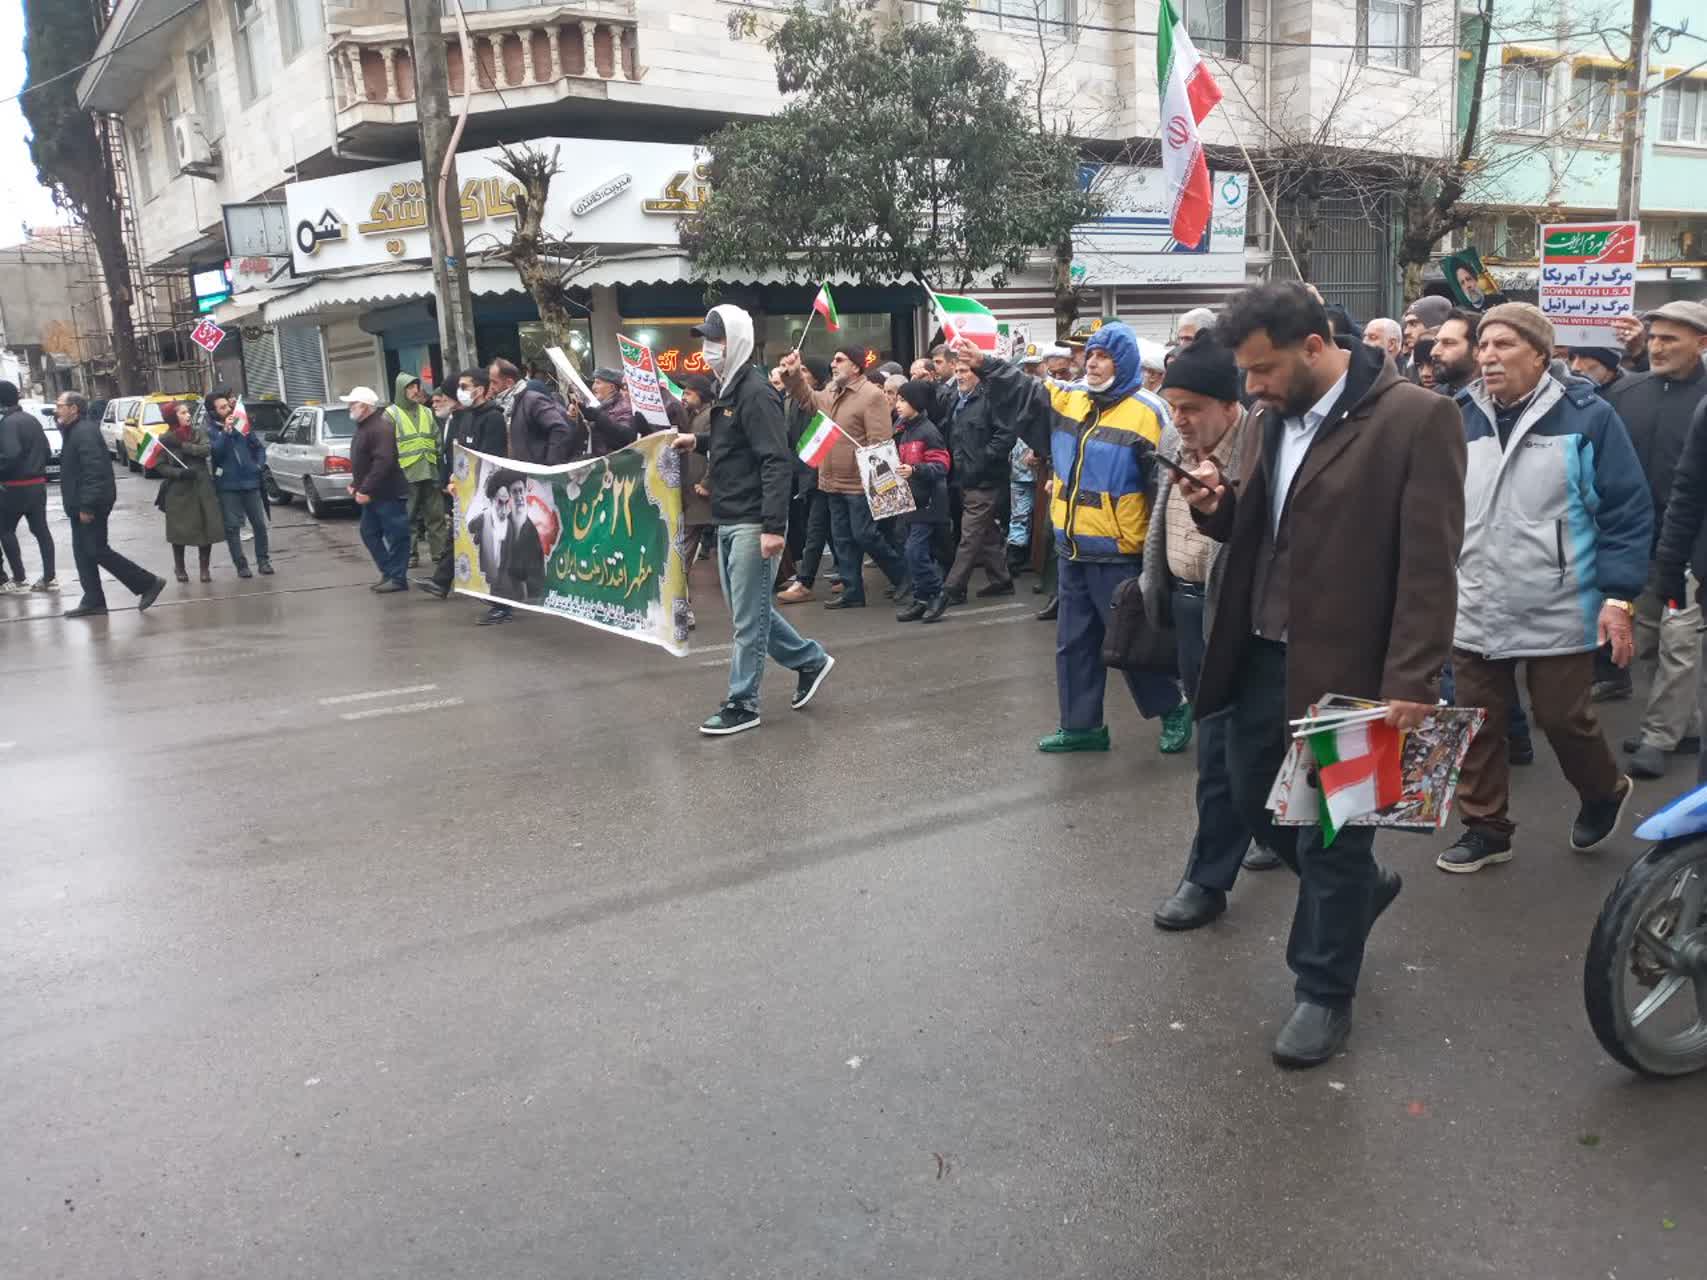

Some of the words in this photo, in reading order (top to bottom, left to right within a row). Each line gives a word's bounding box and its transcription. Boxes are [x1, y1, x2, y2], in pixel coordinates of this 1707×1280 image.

[1543, 265, 1587, 286] آمریکا
[1585, 272, 1600, 286] بر
[1602, 267, 1632, 286] مرگ
[1543, 287, 1573, 296] DOWN
[1574, 287, 1600, 296] WITH
[1542, 297, 1586, 314] اسرائیل
[1586, 302, 1599, 315] بر
[1602, 300, 1630, 315] مرگ
[611, 474, 636, 537] ۲۲
